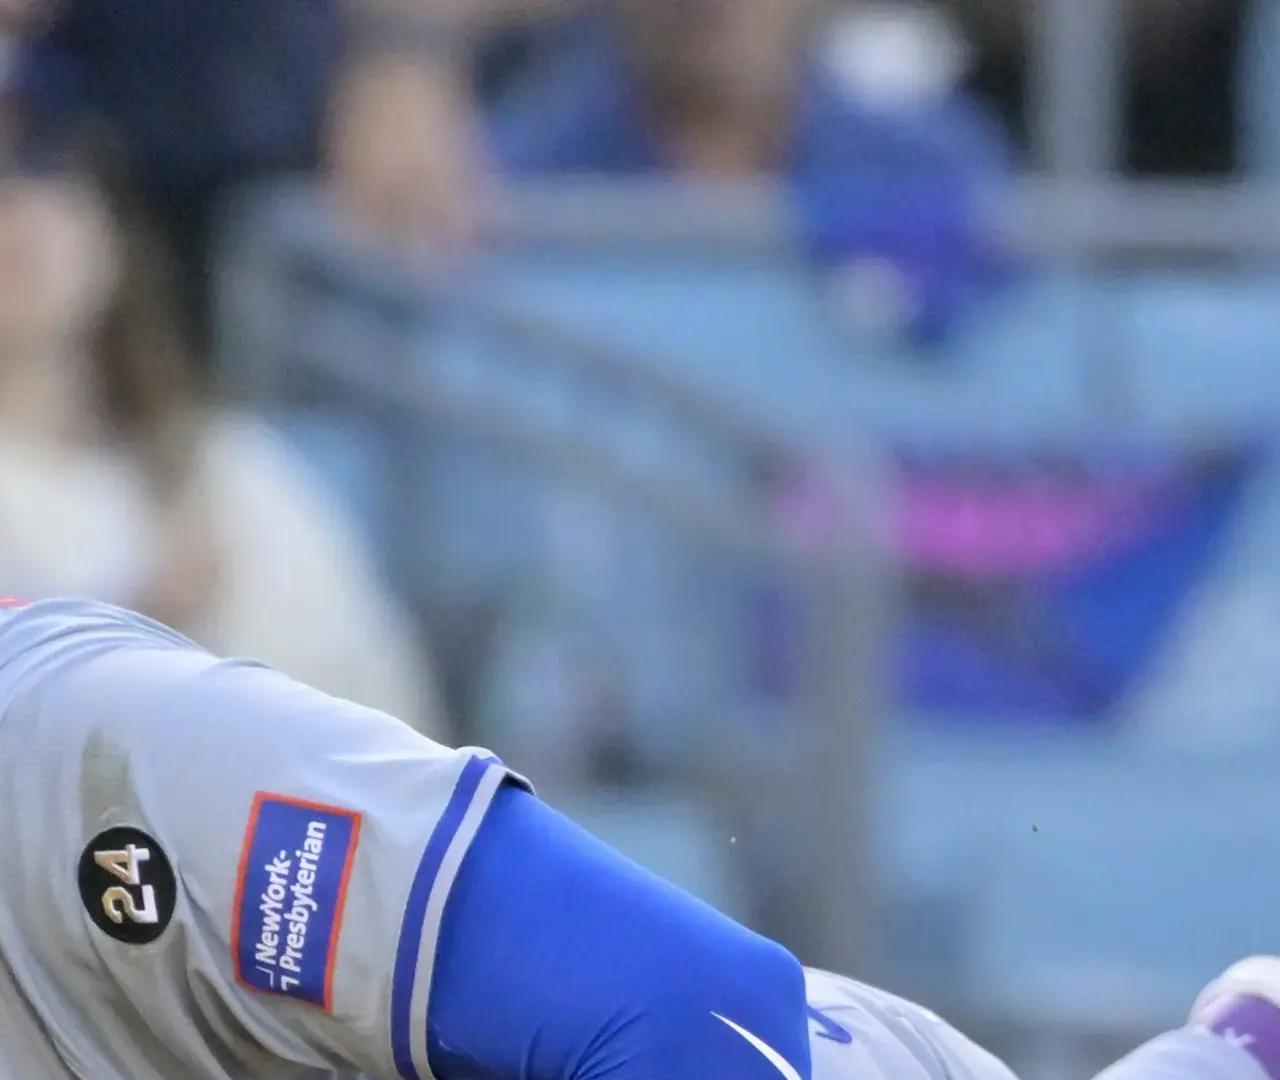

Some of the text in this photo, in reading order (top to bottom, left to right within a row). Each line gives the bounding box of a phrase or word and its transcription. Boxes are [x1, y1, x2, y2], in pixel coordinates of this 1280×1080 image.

[93, 843, 158, 924] 24
[254, 849, 293, 966] NewYork-
[278, 819, 327, 974] Presbyterian
